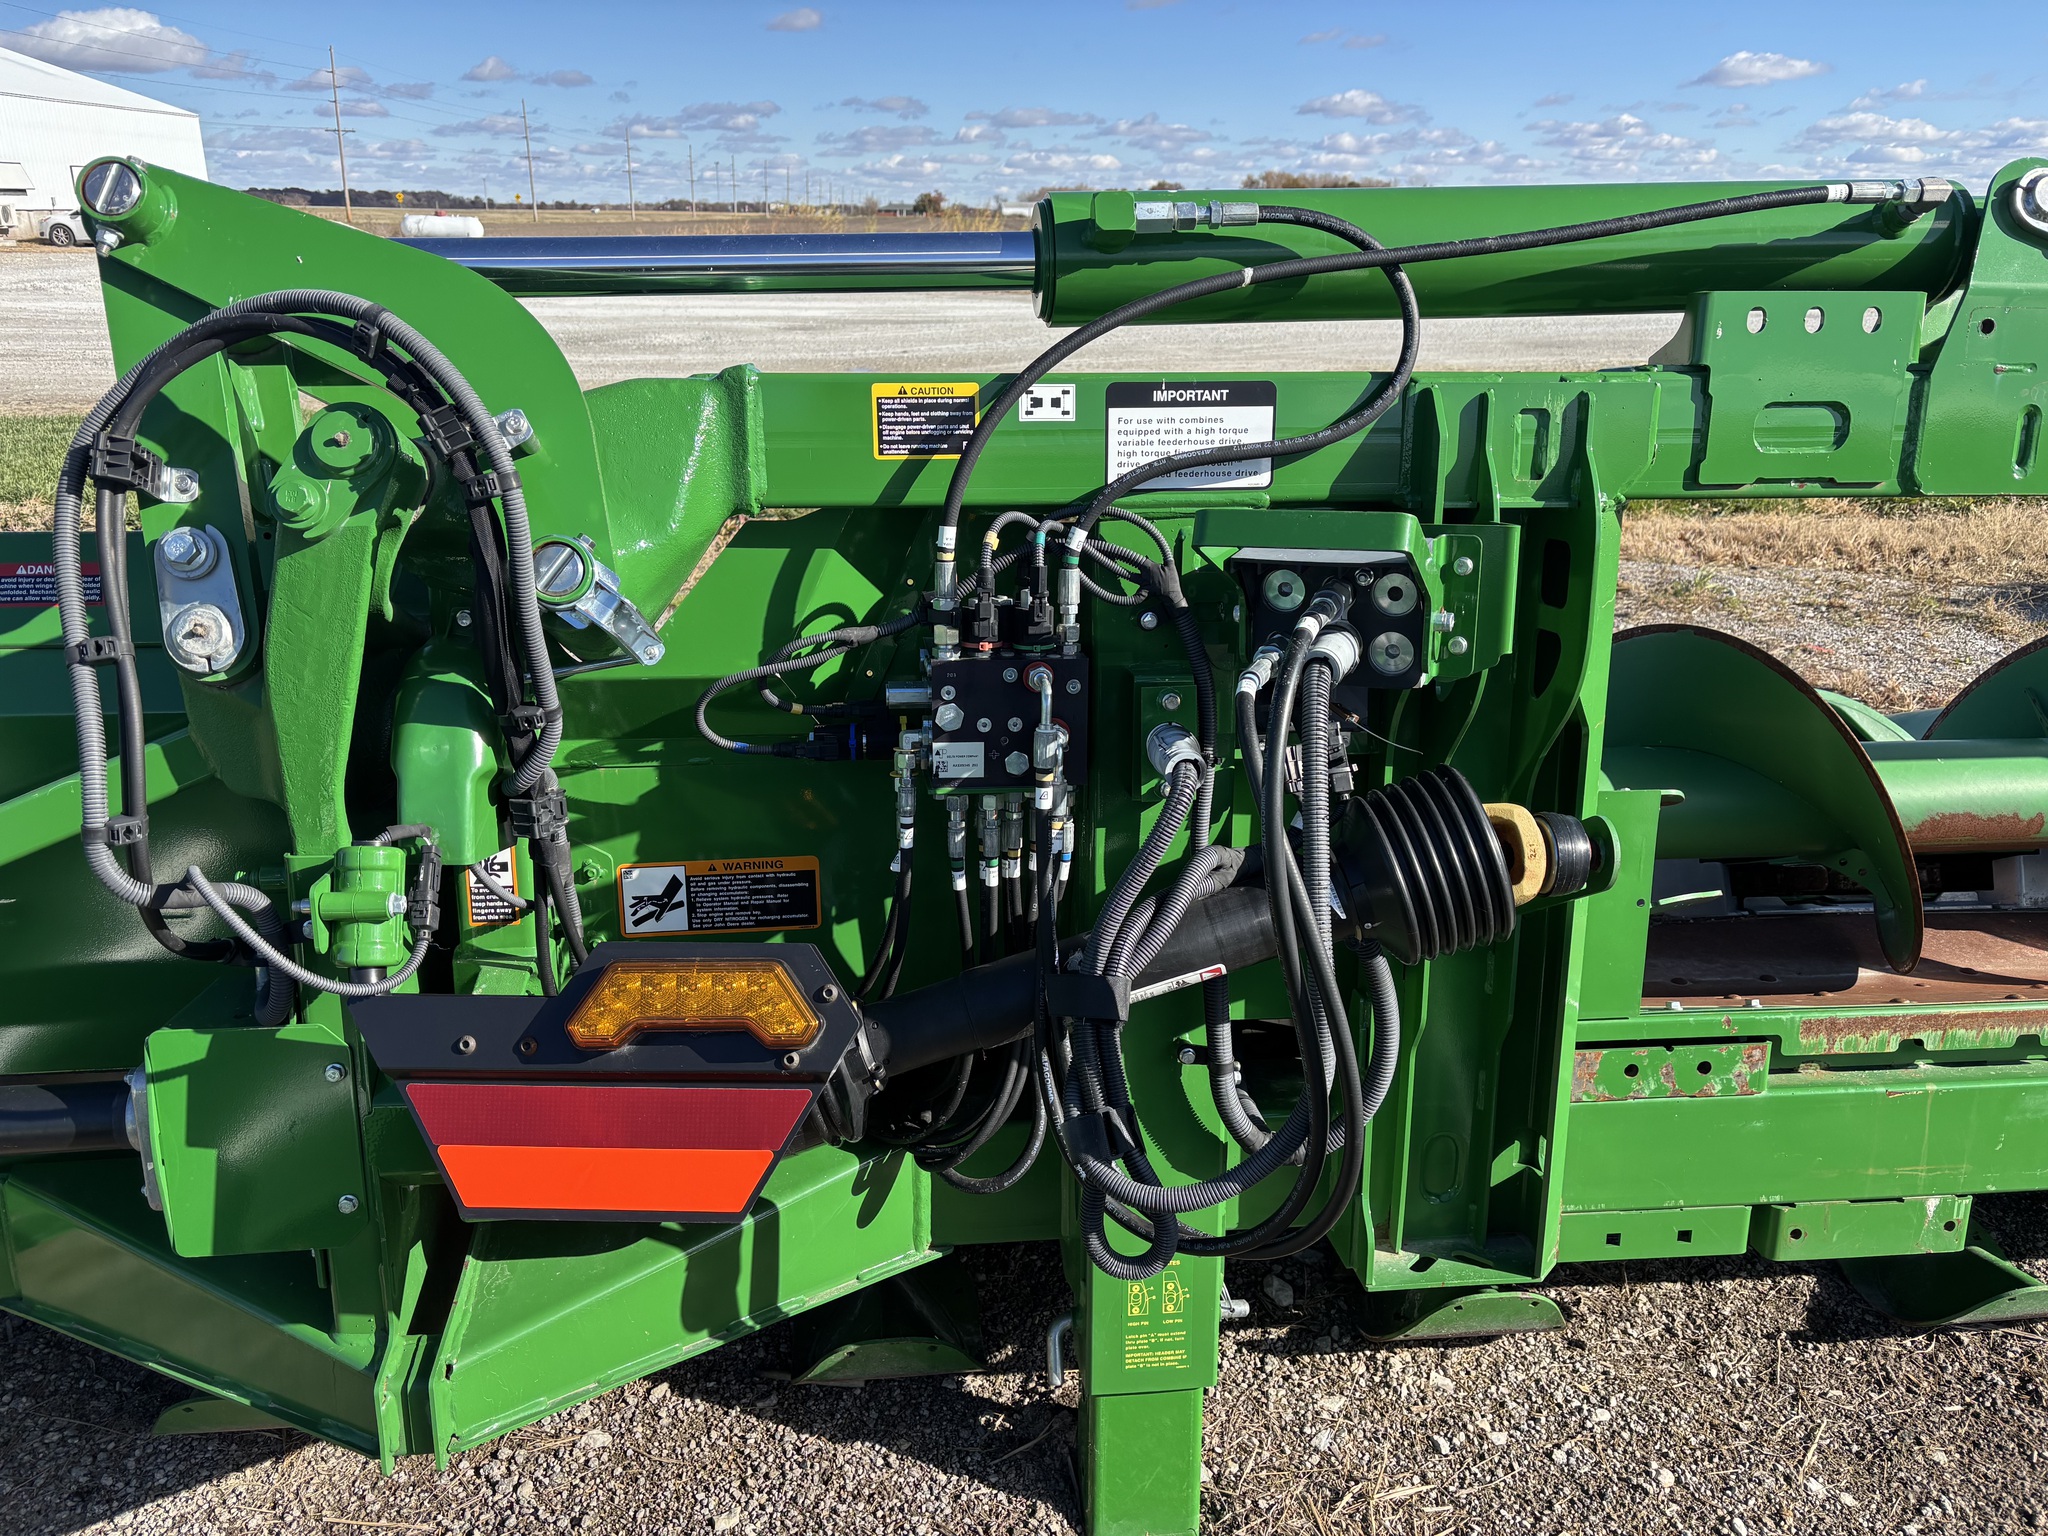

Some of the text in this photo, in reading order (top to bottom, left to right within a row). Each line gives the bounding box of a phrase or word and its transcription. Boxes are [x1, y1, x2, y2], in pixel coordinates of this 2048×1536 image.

[911, 387, 954, 395] CAUTION
[1153, 390, 1229, 402] IMPORTANT
[1118, 417, 1133, 425] For
[1179, 416, 1224, 424] combines
[1118, 428, 1161, 437] equipped
[1195, 427, 1215, 436] high
[1219, 427, 1249, 435] torque
[1158, 438, 1215, 446] feederhouse
[1118, 450, 1137, 458] high
[1141, 449, 1171, 458] torque
[1175, 470, 1233, 478] feederhouse
[1235, 469, 1261, 477] drive.
[28, 565, 55, 574] DAN
[722, 860, 784, 871] WARNING
